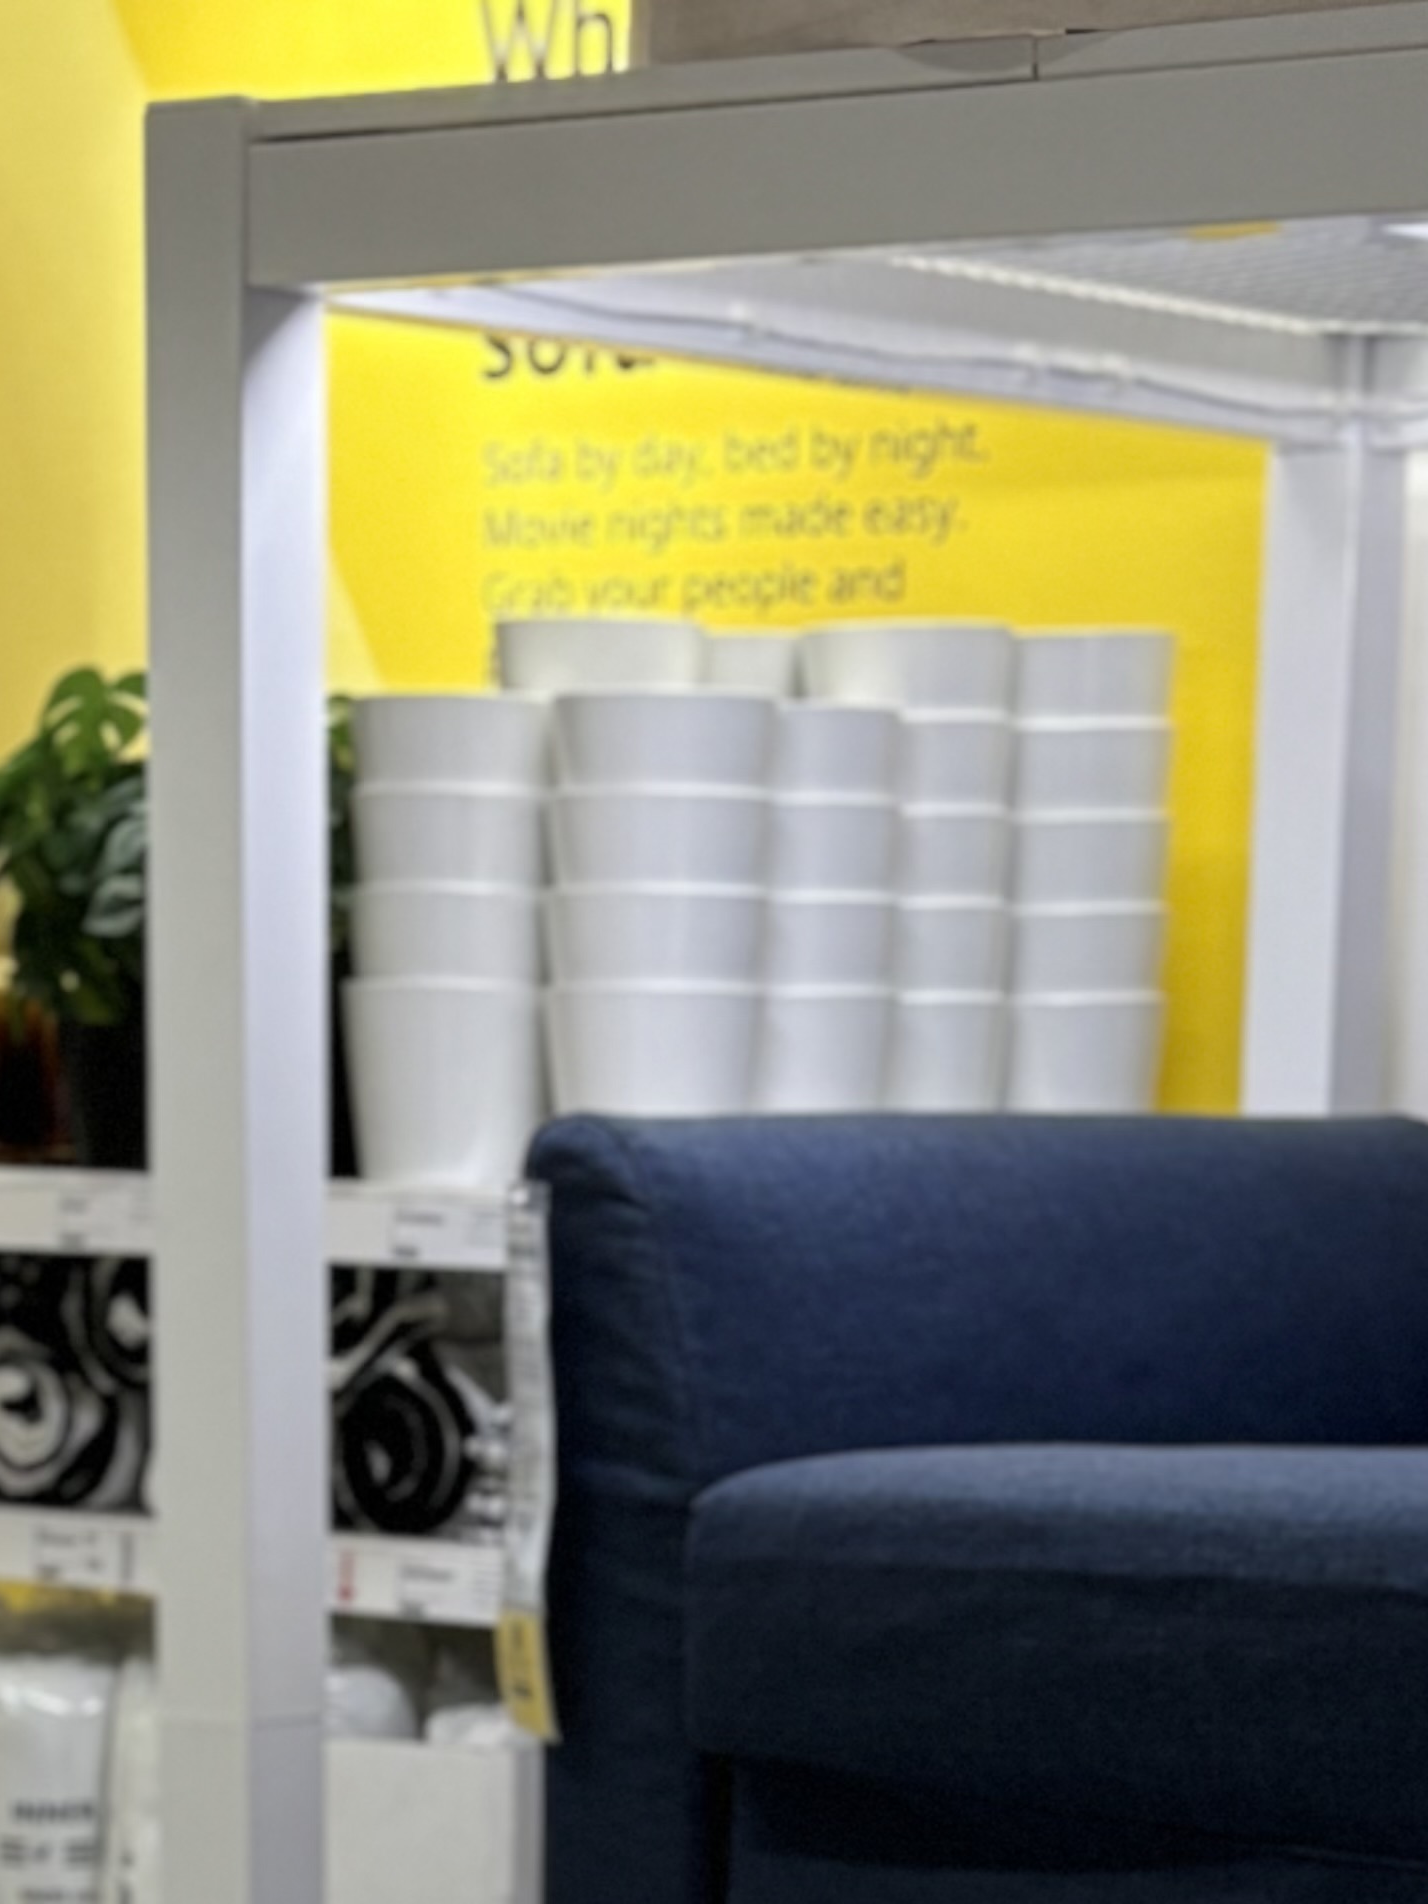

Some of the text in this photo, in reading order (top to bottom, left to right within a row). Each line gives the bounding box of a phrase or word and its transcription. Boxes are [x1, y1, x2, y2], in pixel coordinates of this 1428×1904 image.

[483, 335, 655, 378] so
[483, 439, 562, 488] Sofa
[574, 435, 618, 493] by
[724, 426, 798, 474] bed
[810, 424, 861, 482] by
[483, 508, 594, 548] Movie
[606, 500, 725, 556] nights
[740, 489, 852, 539] made
[483, 556, 907, 617] Grab your people and
